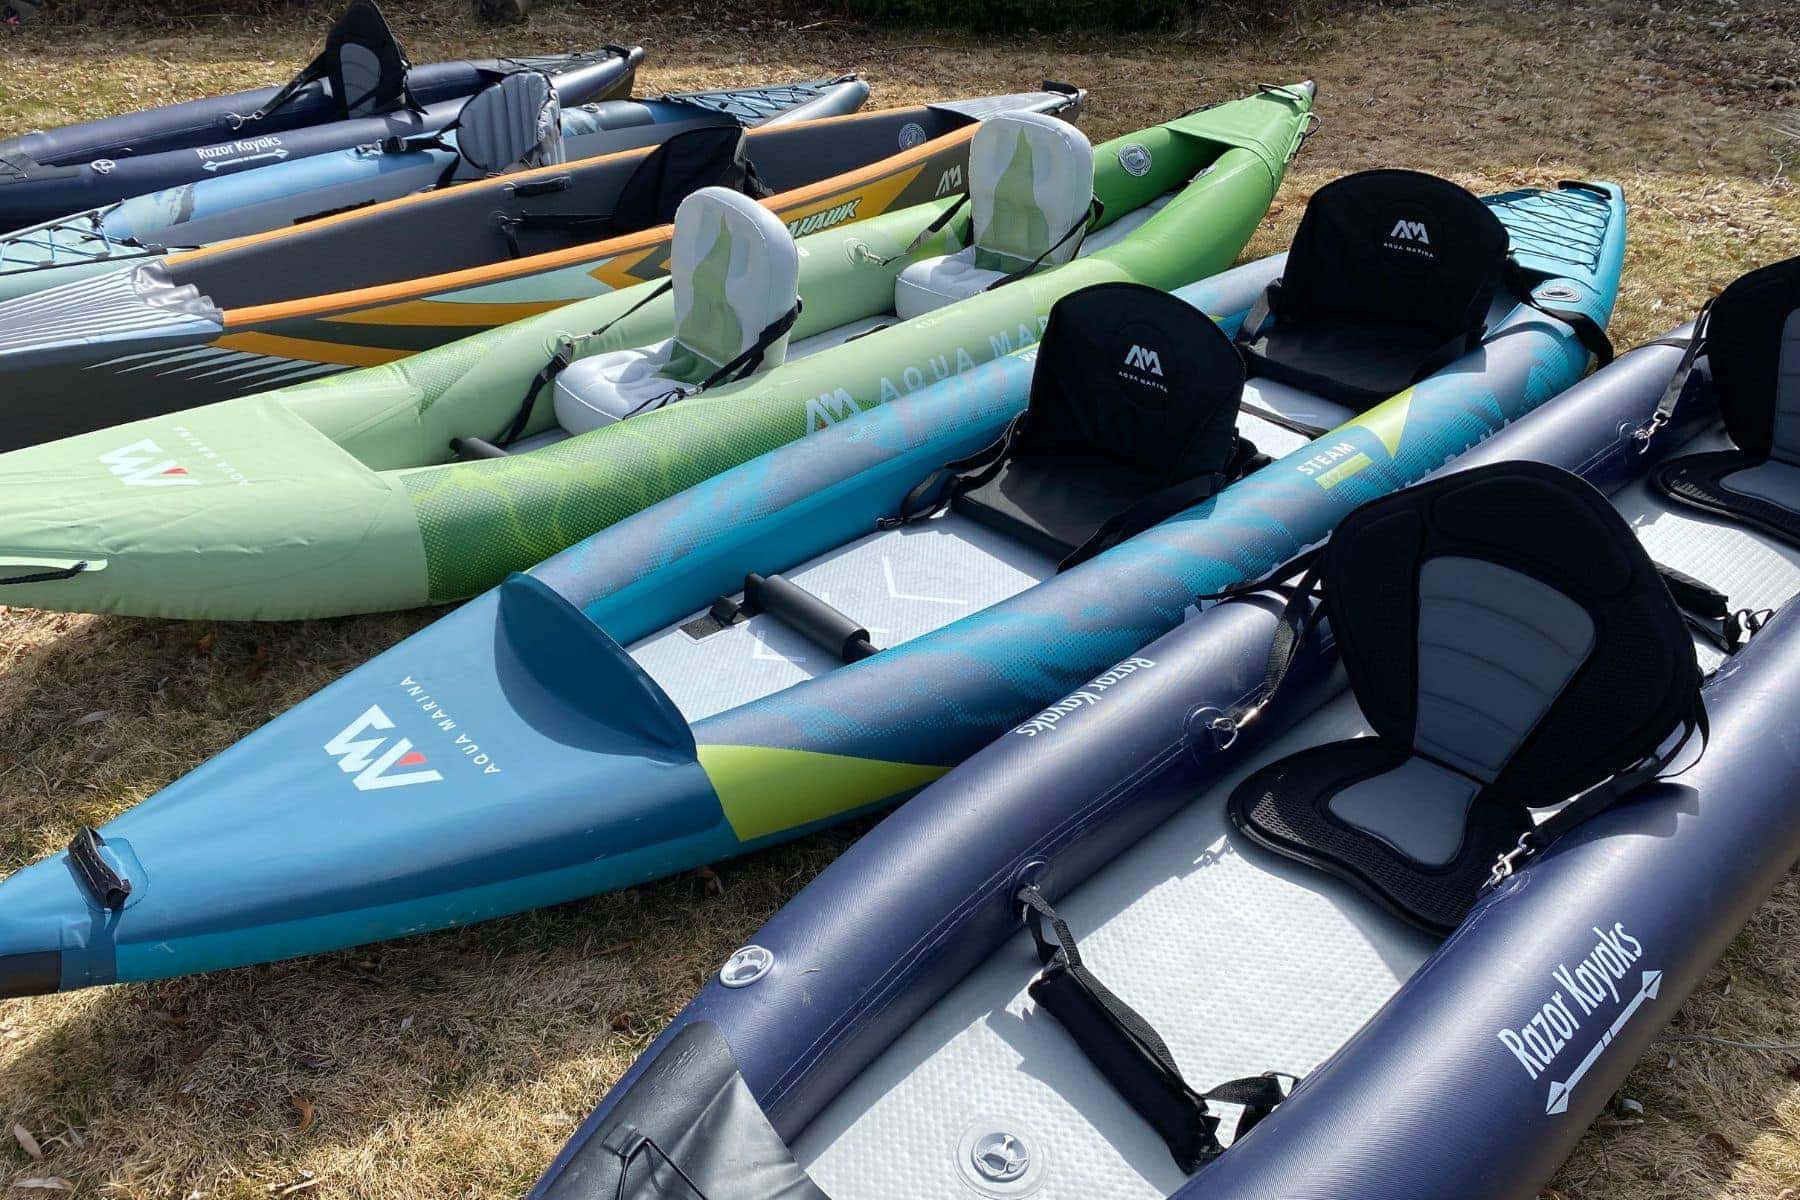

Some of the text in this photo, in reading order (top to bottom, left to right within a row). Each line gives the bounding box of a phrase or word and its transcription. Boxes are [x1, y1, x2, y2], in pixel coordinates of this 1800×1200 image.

[196, 136, 283, 160] Razor Kayaks
[1390, 220, 1430, 245] AM
[880, 347, 974, 402] AQUA
[1124, 344, 1163, 376] AM
[1297, 441, 1356, 476] STEAM
[1015, 657, 1157, 737] Razor Kayaks
[323, 704, 445, 791] AM
[400, 675, 502, 775] AQUA MARINA
[1497, 922, 1643, 1080] Razor Kayaks
